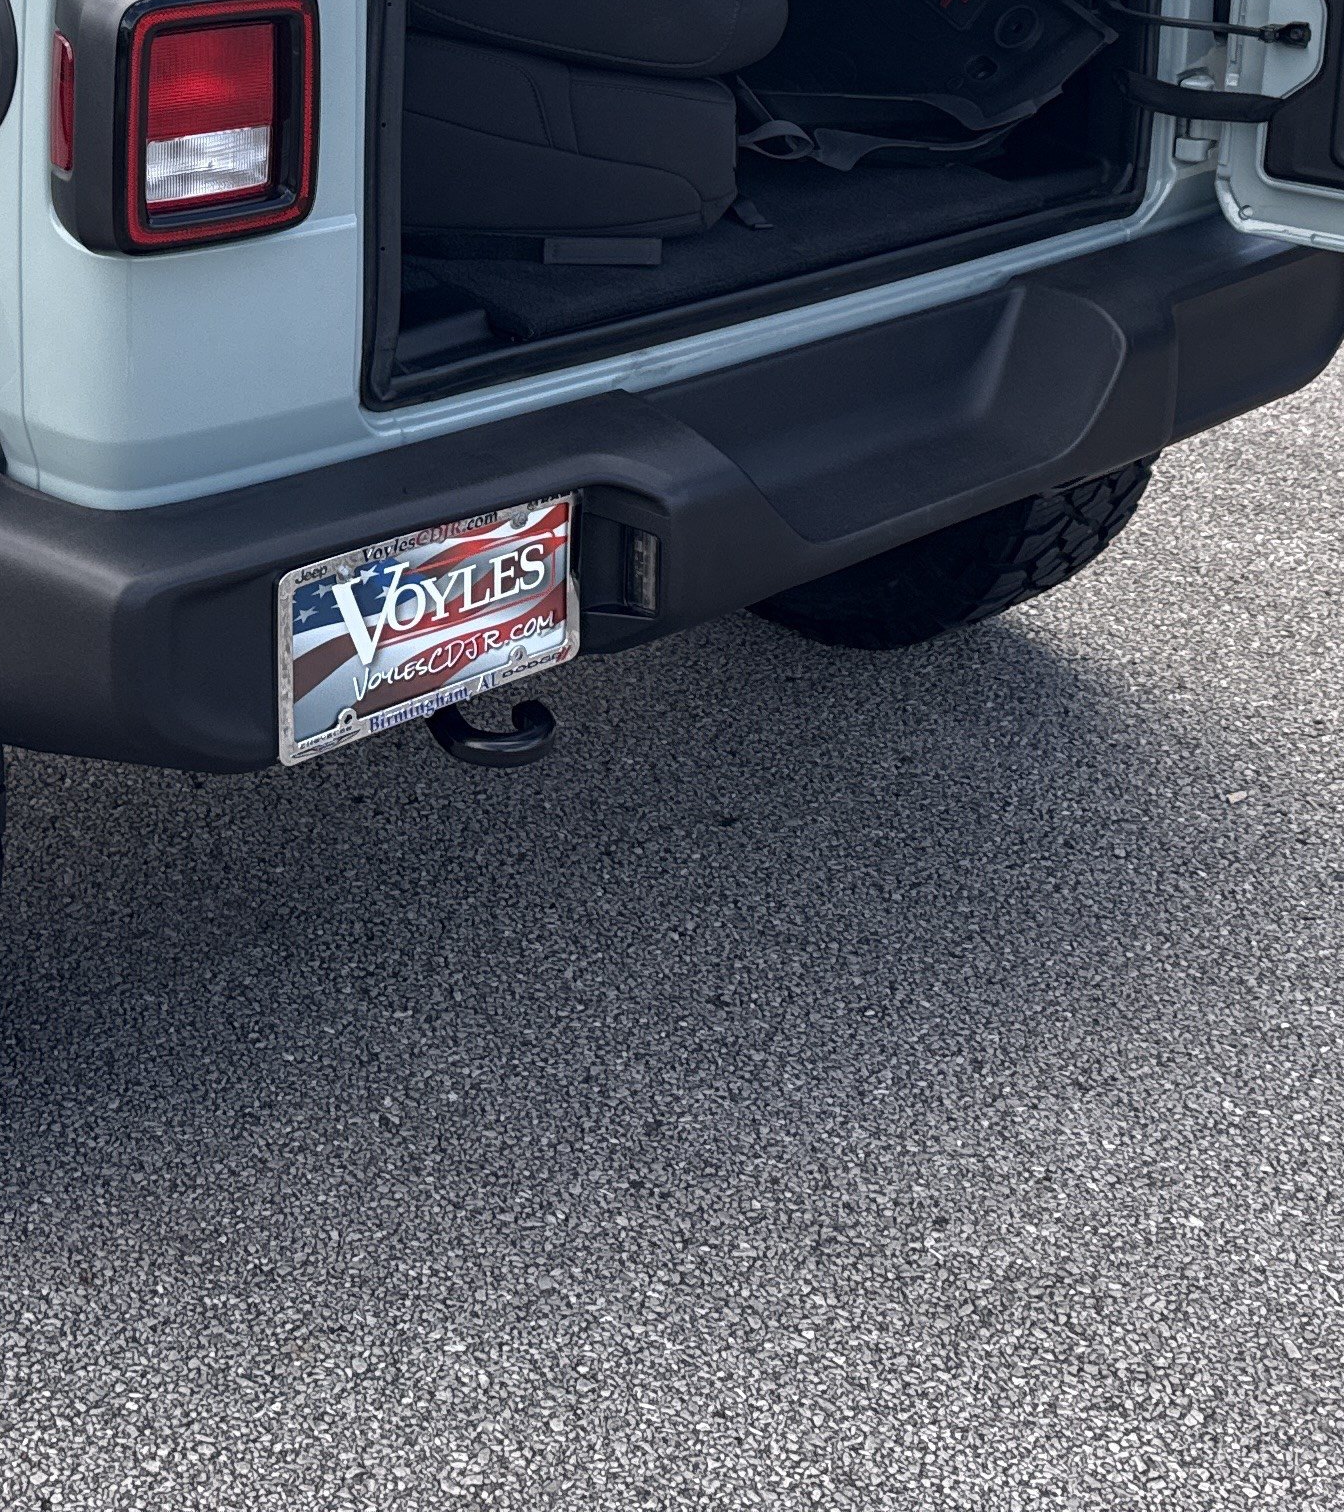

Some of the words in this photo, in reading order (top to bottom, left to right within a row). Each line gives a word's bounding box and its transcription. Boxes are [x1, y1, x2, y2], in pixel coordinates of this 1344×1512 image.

[361, 511, 498, 563] VoylesCDJR.com
[294, 565, 328, 585] Jeep
[331, 542, 546, 666] VOYLES
[368, 685, 472, 734] Birmingham,
[479, 672, 502, 692] AL
